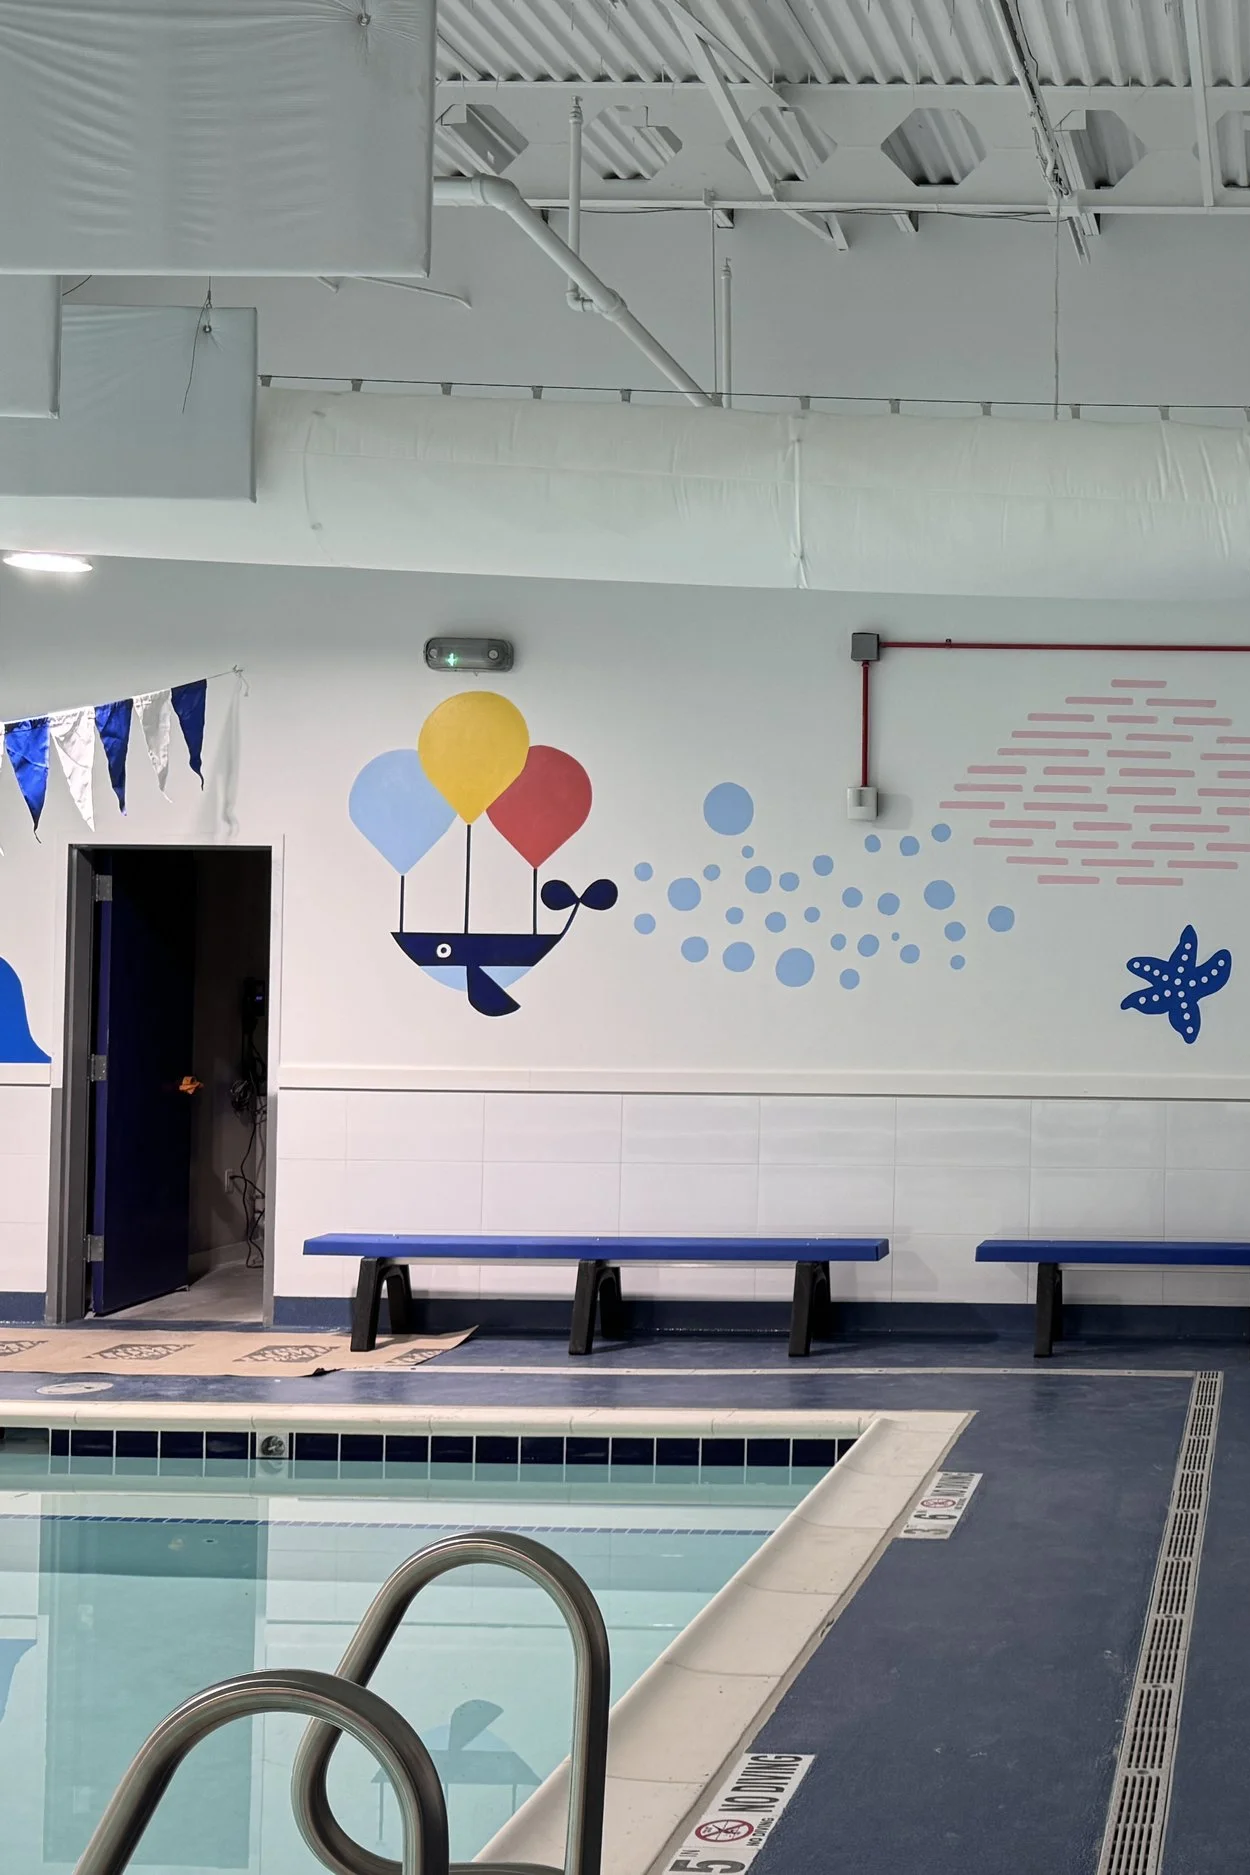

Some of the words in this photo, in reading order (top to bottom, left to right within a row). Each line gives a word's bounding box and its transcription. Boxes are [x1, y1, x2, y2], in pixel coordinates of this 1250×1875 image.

[731, 1755, 803, 1793] DIVING
[717, 1796, 780, 1813] NO
[752, 1817, 775, 1836] DIVING
[746, 1837, 763, 1846] NO
[669, 1859, 746, 1874] 5
